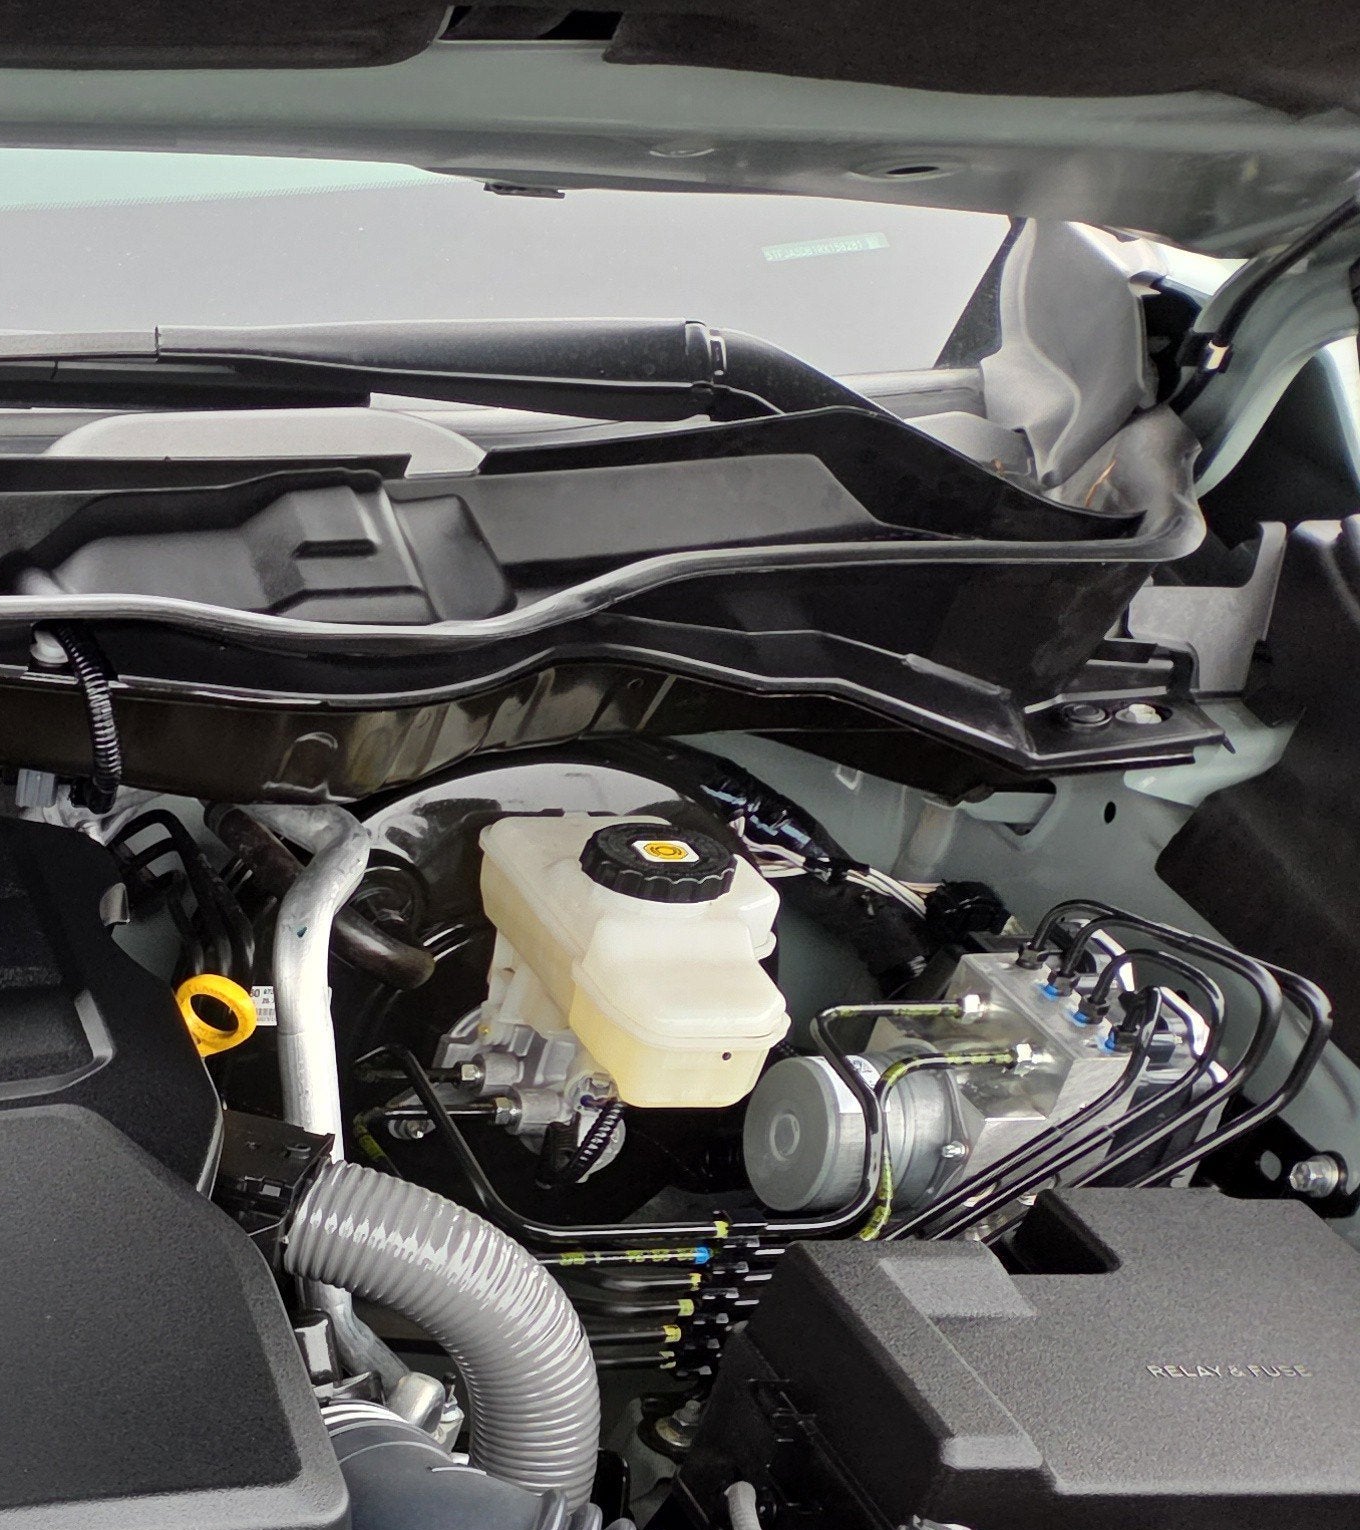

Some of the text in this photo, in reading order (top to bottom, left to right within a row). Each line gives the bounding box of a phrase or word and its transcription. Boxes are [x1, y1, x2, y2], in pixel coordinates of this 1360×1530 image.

[1146, 1364, 1313, 1378] RELAY & FUSE
